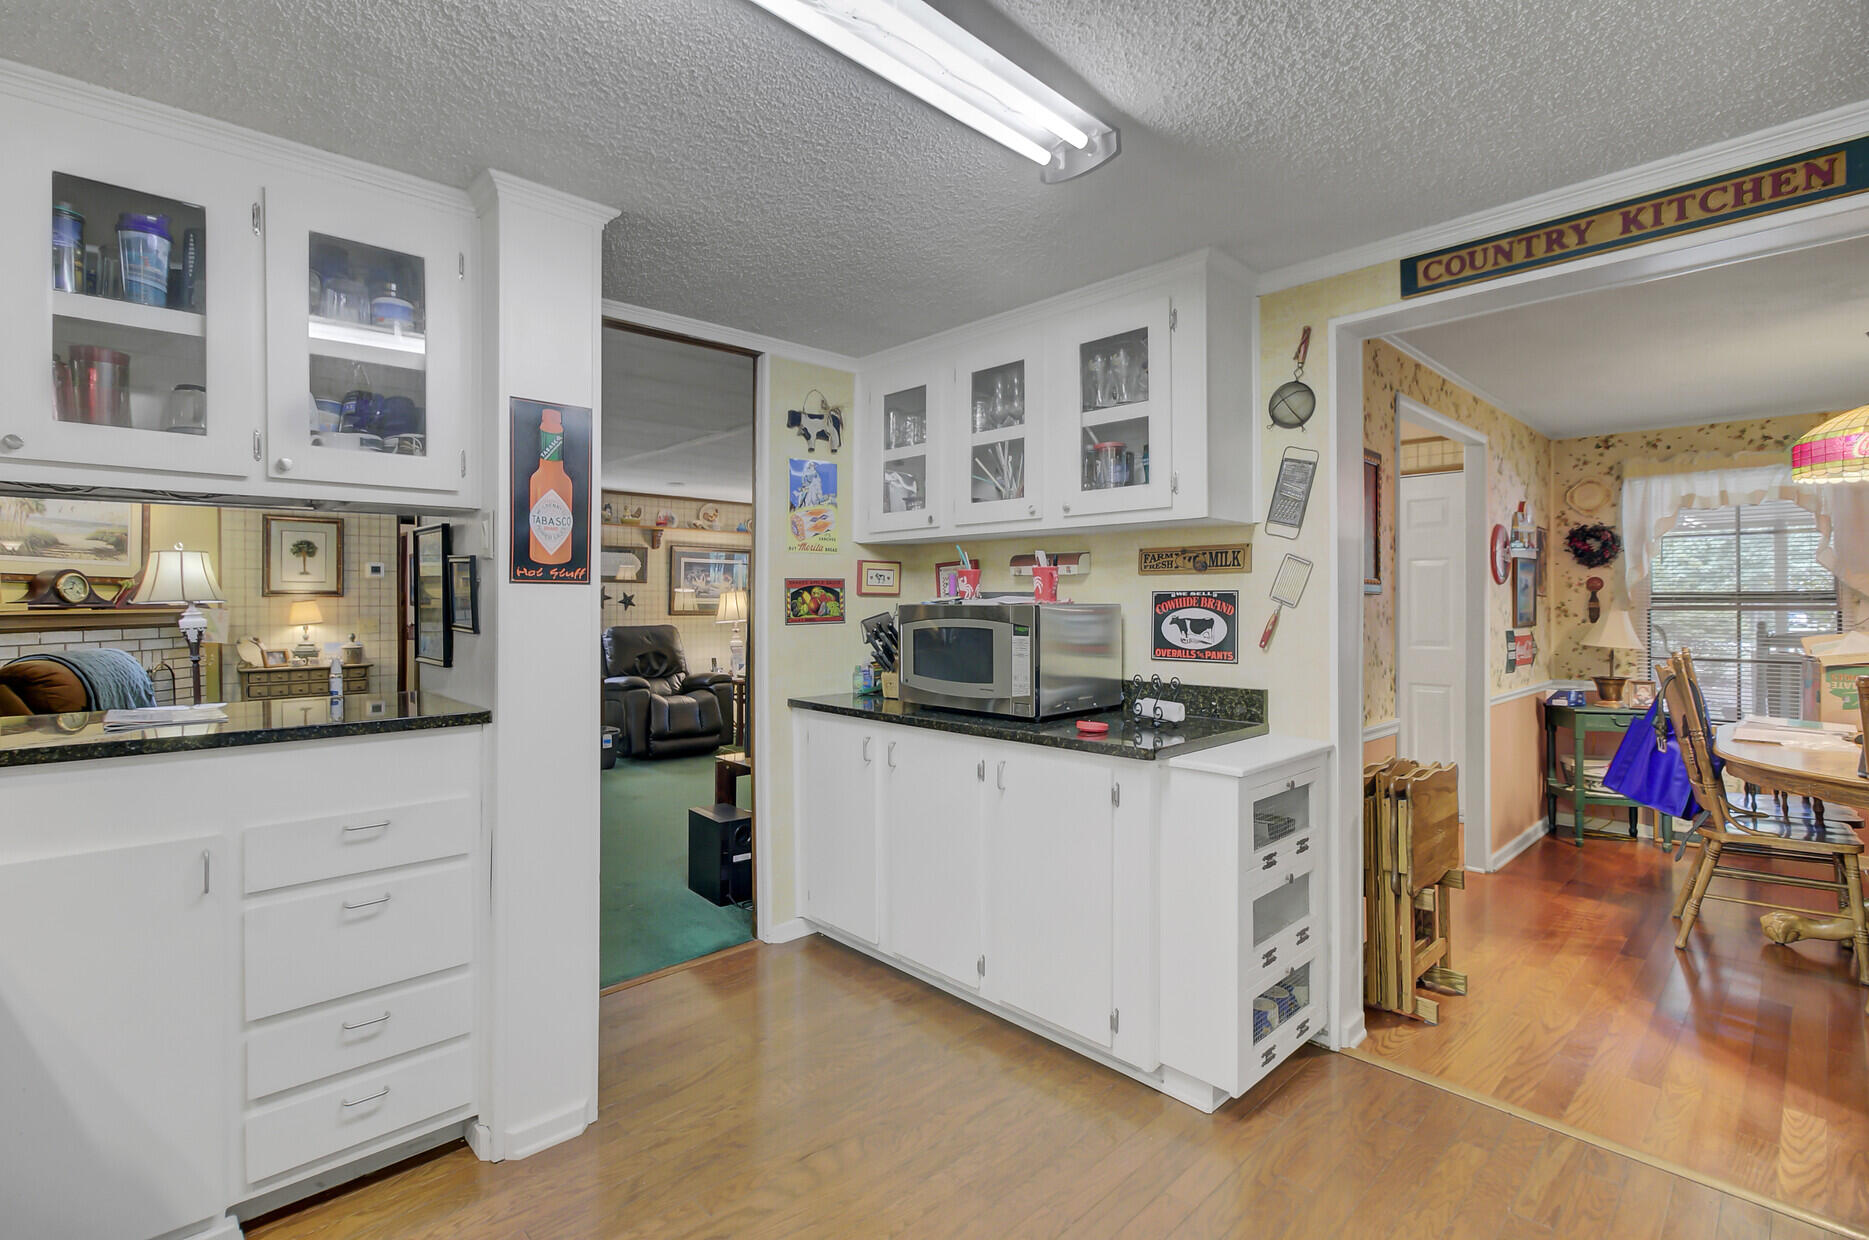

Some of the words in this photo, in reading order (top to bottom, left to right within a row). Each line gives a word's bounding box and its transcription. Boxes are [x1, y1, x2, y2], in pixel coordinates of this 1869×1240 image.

[1422, 219, 1595, 282] COUNTRY
[1619, 157, 1838, 236] KITCHEN
[531, 515, 571, 527] TABASCO
[1143, 552, 1173, 564] FARM
[1208, 550, 1242, 568] MILK
[1143, 560, 1173, 570] FRESH
[1155, 596, 1200, 615] COWHIDE
[1200, 596, 1235, 616] BRAND
[1155, 648, 1197, 659] OVERALLS
[1204, 650, 1234, 661] PANTS
